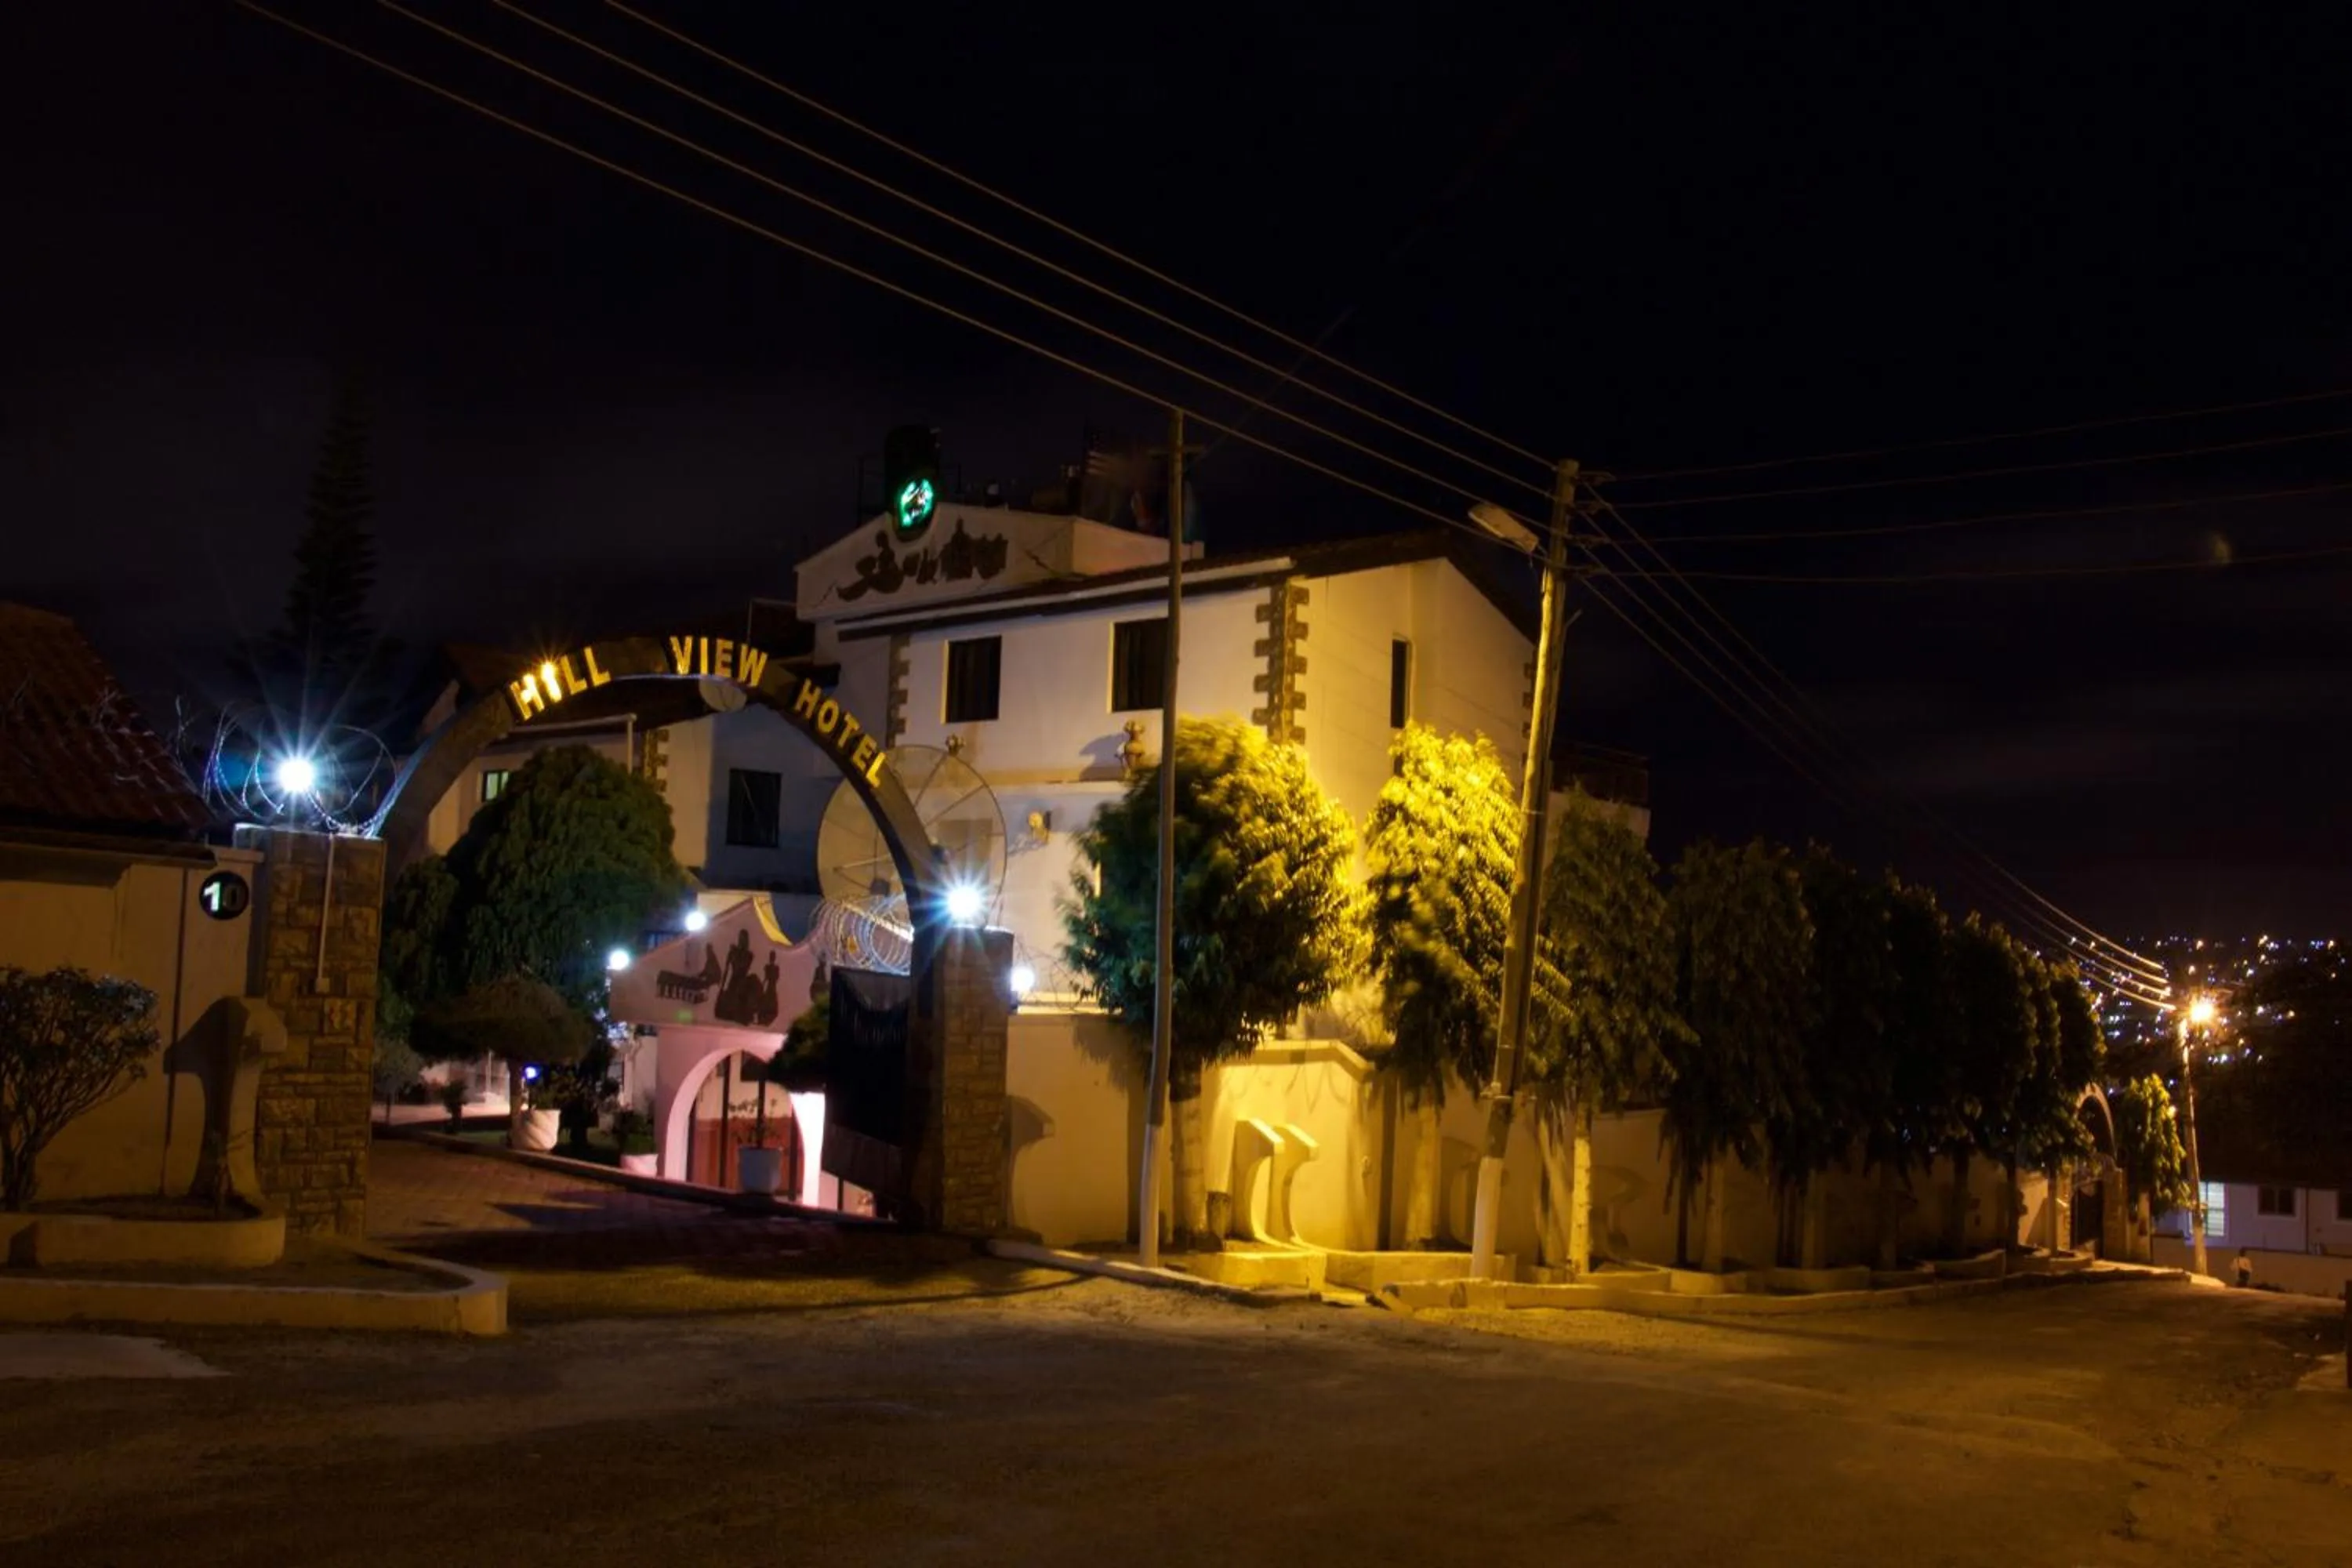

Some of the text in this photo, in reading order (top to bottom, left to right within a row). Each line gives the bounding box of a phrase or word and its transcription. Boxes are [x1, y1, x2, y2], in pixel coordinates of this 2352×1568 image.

[510, 636, 887, 788] HILL VIEW HOTEL
